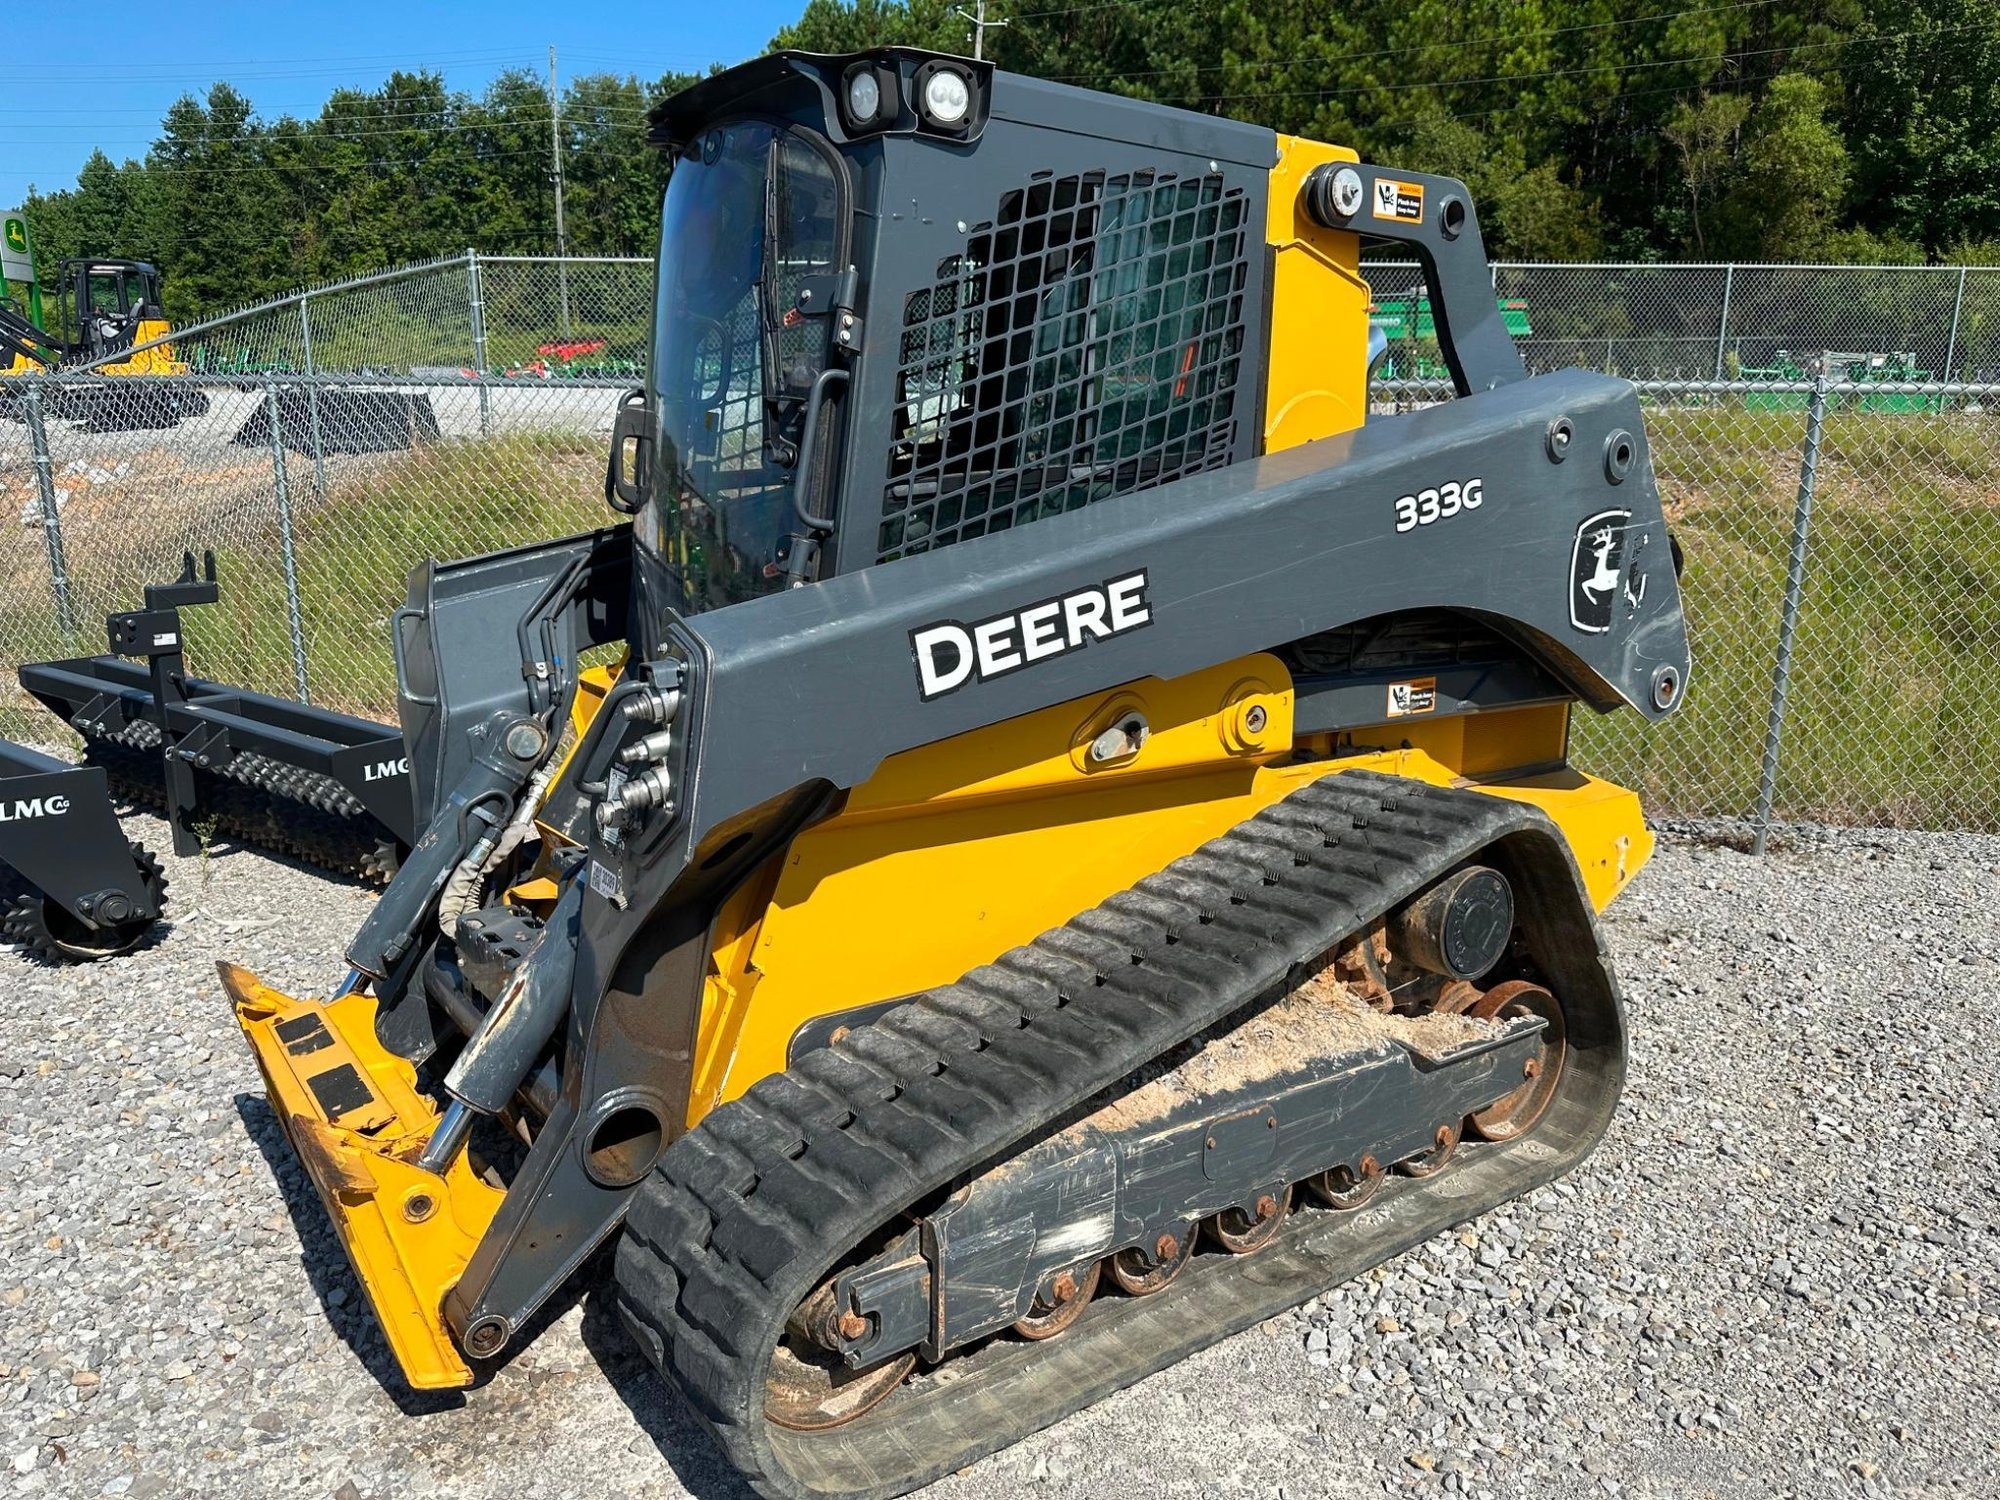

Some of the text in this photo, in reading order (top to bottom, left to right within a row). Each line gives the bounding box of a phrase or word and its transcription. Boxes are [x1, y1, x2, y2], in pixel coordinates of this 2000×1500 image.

[1395, 478, 1482, 532] 333G
[914, 574, 1150, 697] DEERE
[0, 795, 67, 821] LMC
